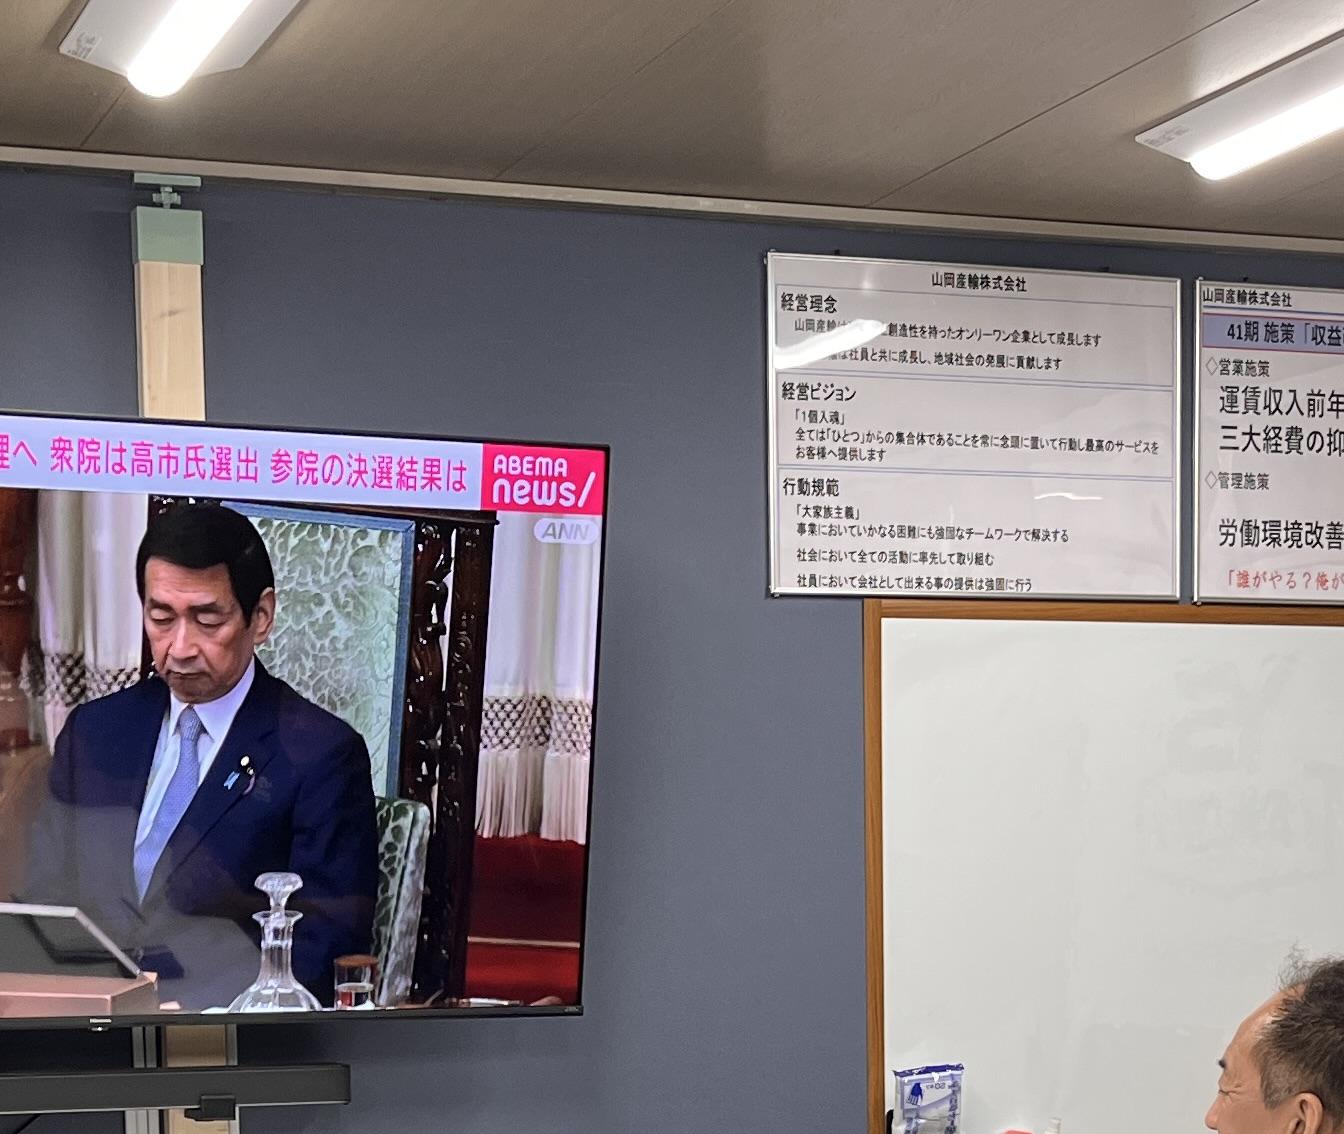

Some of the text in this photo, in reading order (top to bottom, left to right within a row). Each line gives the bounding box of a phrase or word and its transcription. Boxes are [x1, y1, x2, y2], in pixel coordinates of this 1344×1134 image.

[931, 271, 1028, 293] 山岡産輸株式会社
[780, 291, 838, 314] 経営理念
[1202, 287, 1293, 308] 山岡産輸株式会社
[781, 381, 857, 402] 経営ビジョン
[49, 434, 259, 482] 衆院は高市氏選出
[269, 447, 469, 493] 参院の決選結果は
[795, 444, 887, 463] お客様へ提供します
[493, 453, 568, 478] ABEMA
[782, 476, 840, 498] 行動規範
[796, 503, 861, 521] 「大家族主義」
[541, 521, 591, 541] ANN
